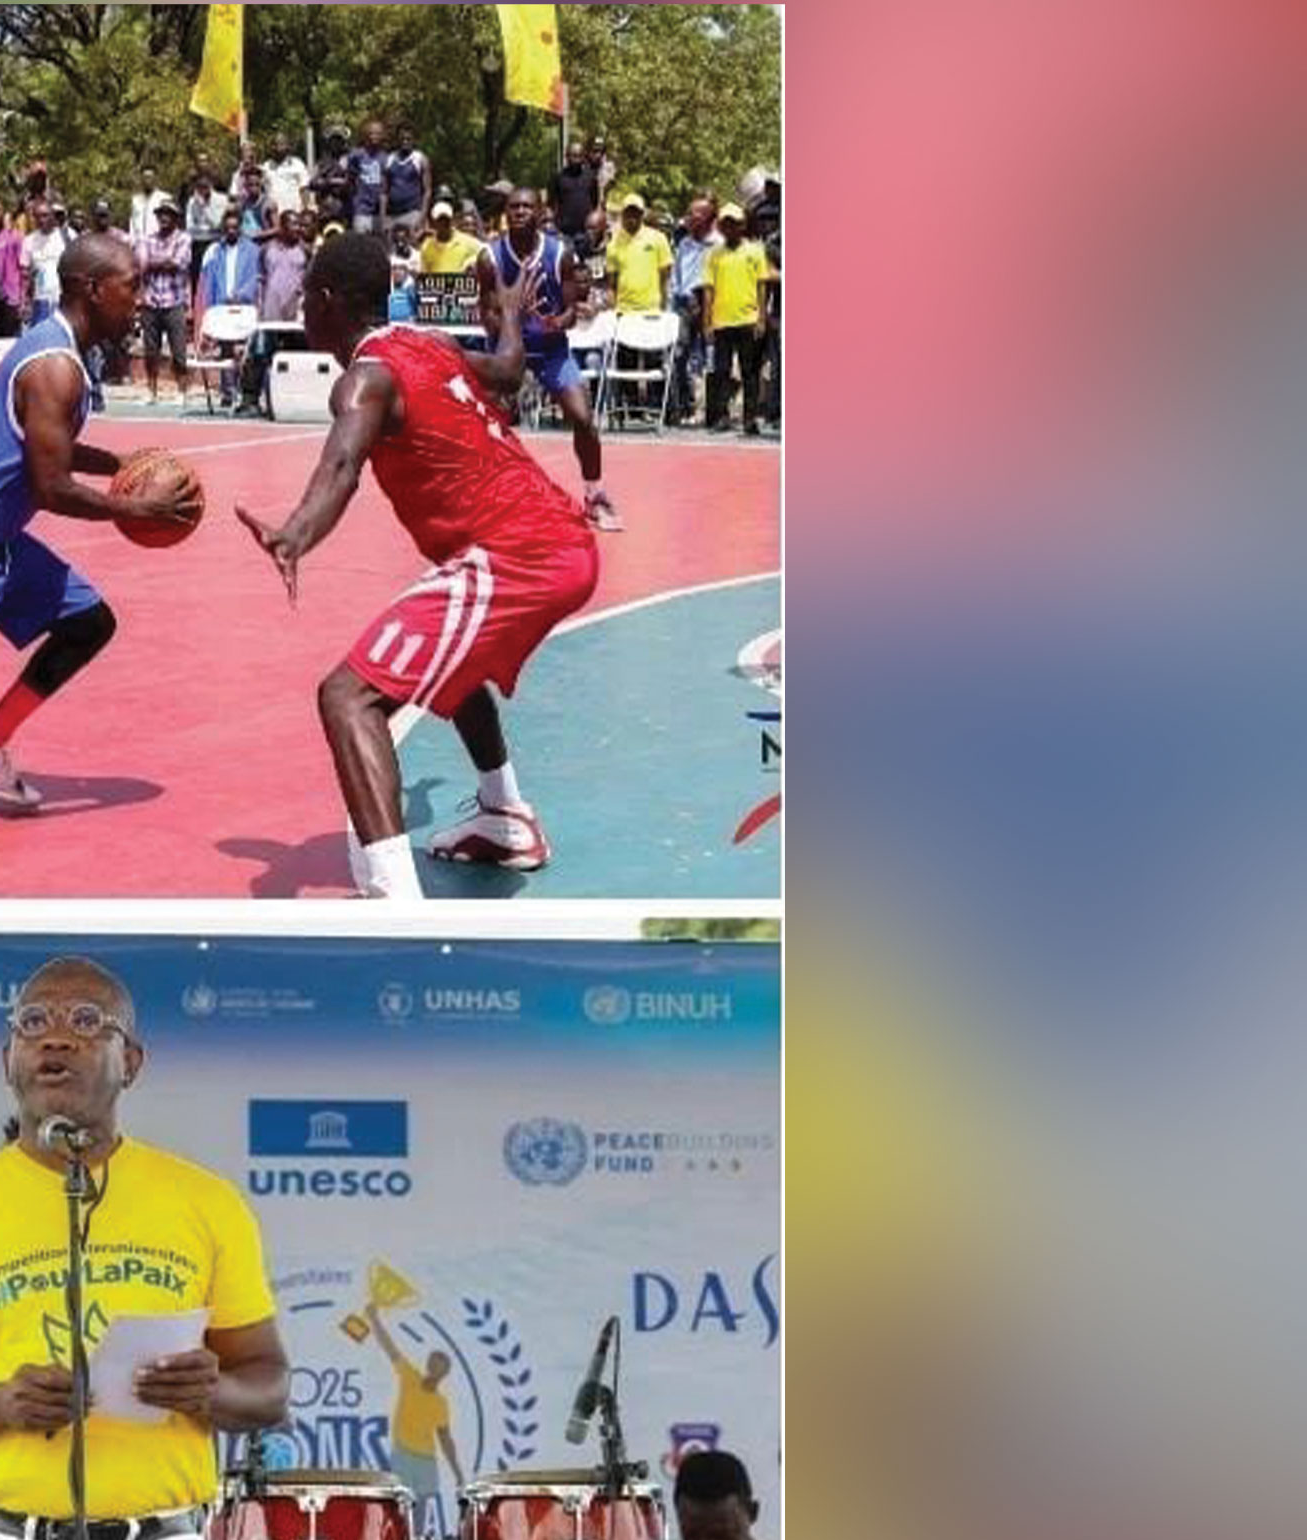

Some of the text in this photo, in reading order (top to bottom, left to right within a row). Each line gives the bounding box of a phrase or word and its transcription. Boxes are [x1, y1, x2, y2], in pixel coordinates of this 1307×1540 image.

[424, 989, 521, 1011] UNHAS
[636, 993, 732, 1020] BINUH
[594, 1156, 653, 1172] FUND
[248, 1167, 412, 1198] unesco
[631, 1253, 780, 1348] DAS
[290, 1368, 363, 1407] 025
